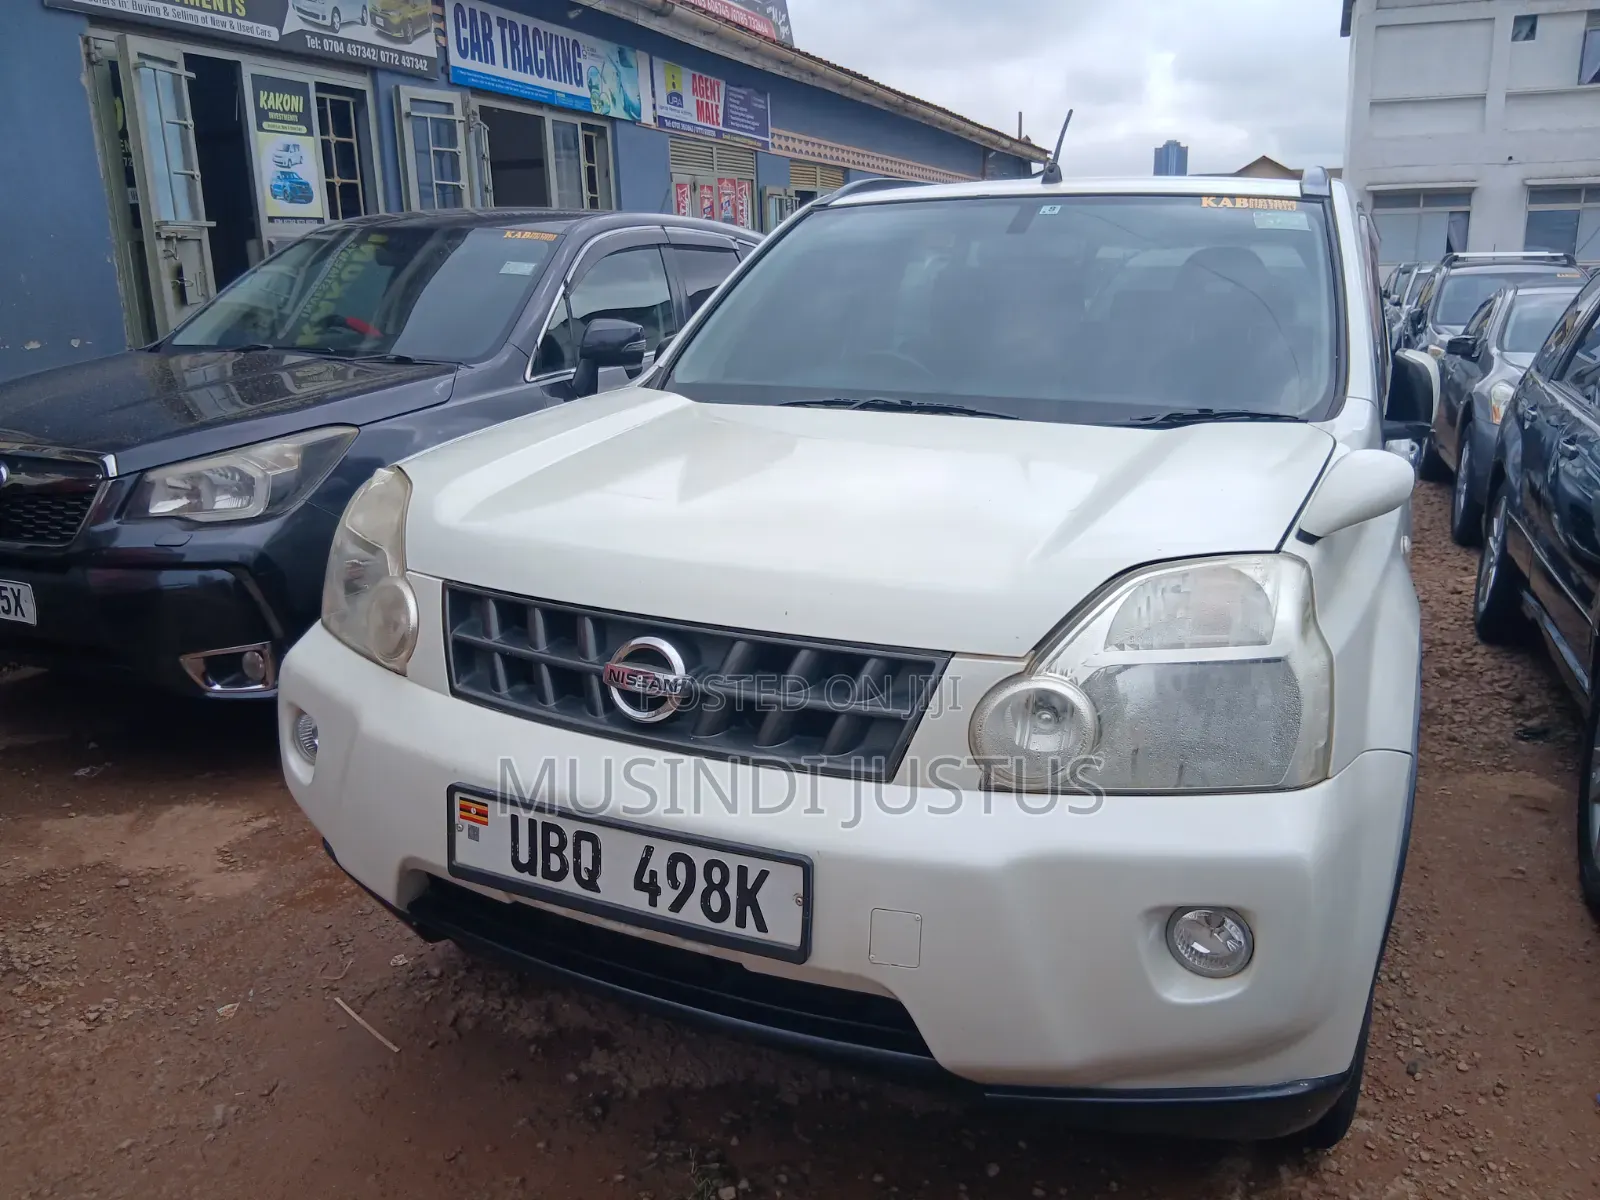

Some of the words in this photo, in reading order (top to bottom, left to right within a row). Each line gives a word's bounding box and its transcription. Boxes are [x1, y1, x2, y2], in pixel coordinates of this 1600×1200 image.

[132, 0, 161, 16] Buying
[163, 6, 170, 17] &
[172, 8, 199, 24] Selling
[210, 16, 227, 29] New
[229, 22, 235, 32] &
[237, 22, 255, 35] Used
[256, 26, 272, 38] Cars
[305, 35, 321, 50] Tel:
[323, 38, 345, 54] 0704
[380, 51, 400, 65] 0772
[401, 55, 428, 71] 437342
[453, 2, 496, 66] CAR
[496, 16, 584, 88] TRACKING
[260, 90, 304, 113] KAKONI
[691, 73, 721, 103] AGENT
[268, 111, 299, 122] INVESTMENTS
[696, 99, 721, 127] MALE
[0, 586, 26, 618] 5X
[609, 668, 678, 693] NISSAN
[510, 813, 602, 894] UBQ
[633, 844, 771, 934] 498K
